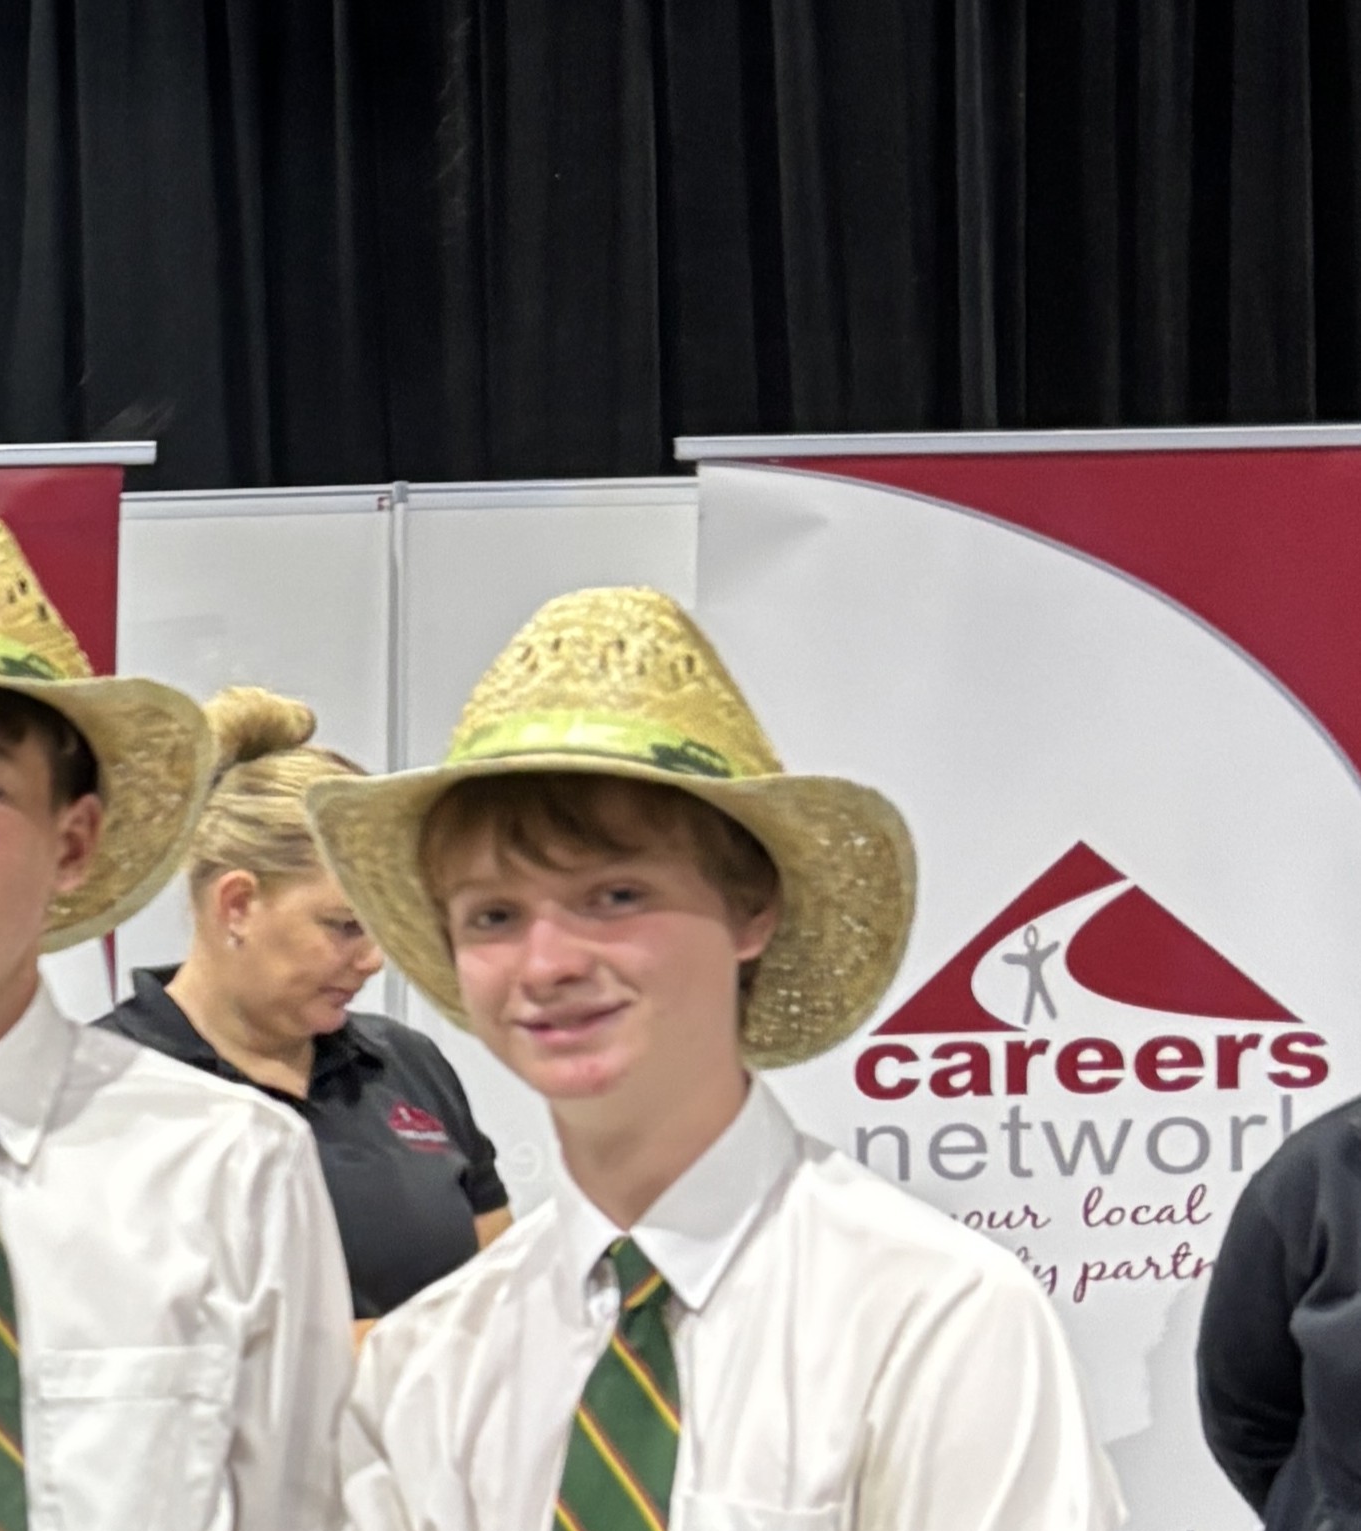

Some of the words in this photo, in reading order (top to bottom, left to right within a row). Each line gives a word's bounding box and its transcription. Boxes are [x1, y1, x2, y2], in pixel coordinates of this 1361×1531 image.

[854, 1030, 1330, 1101] careers
[950, 1203, 1052, 1231] our
[1081, 1183, 1214, 1227] local
